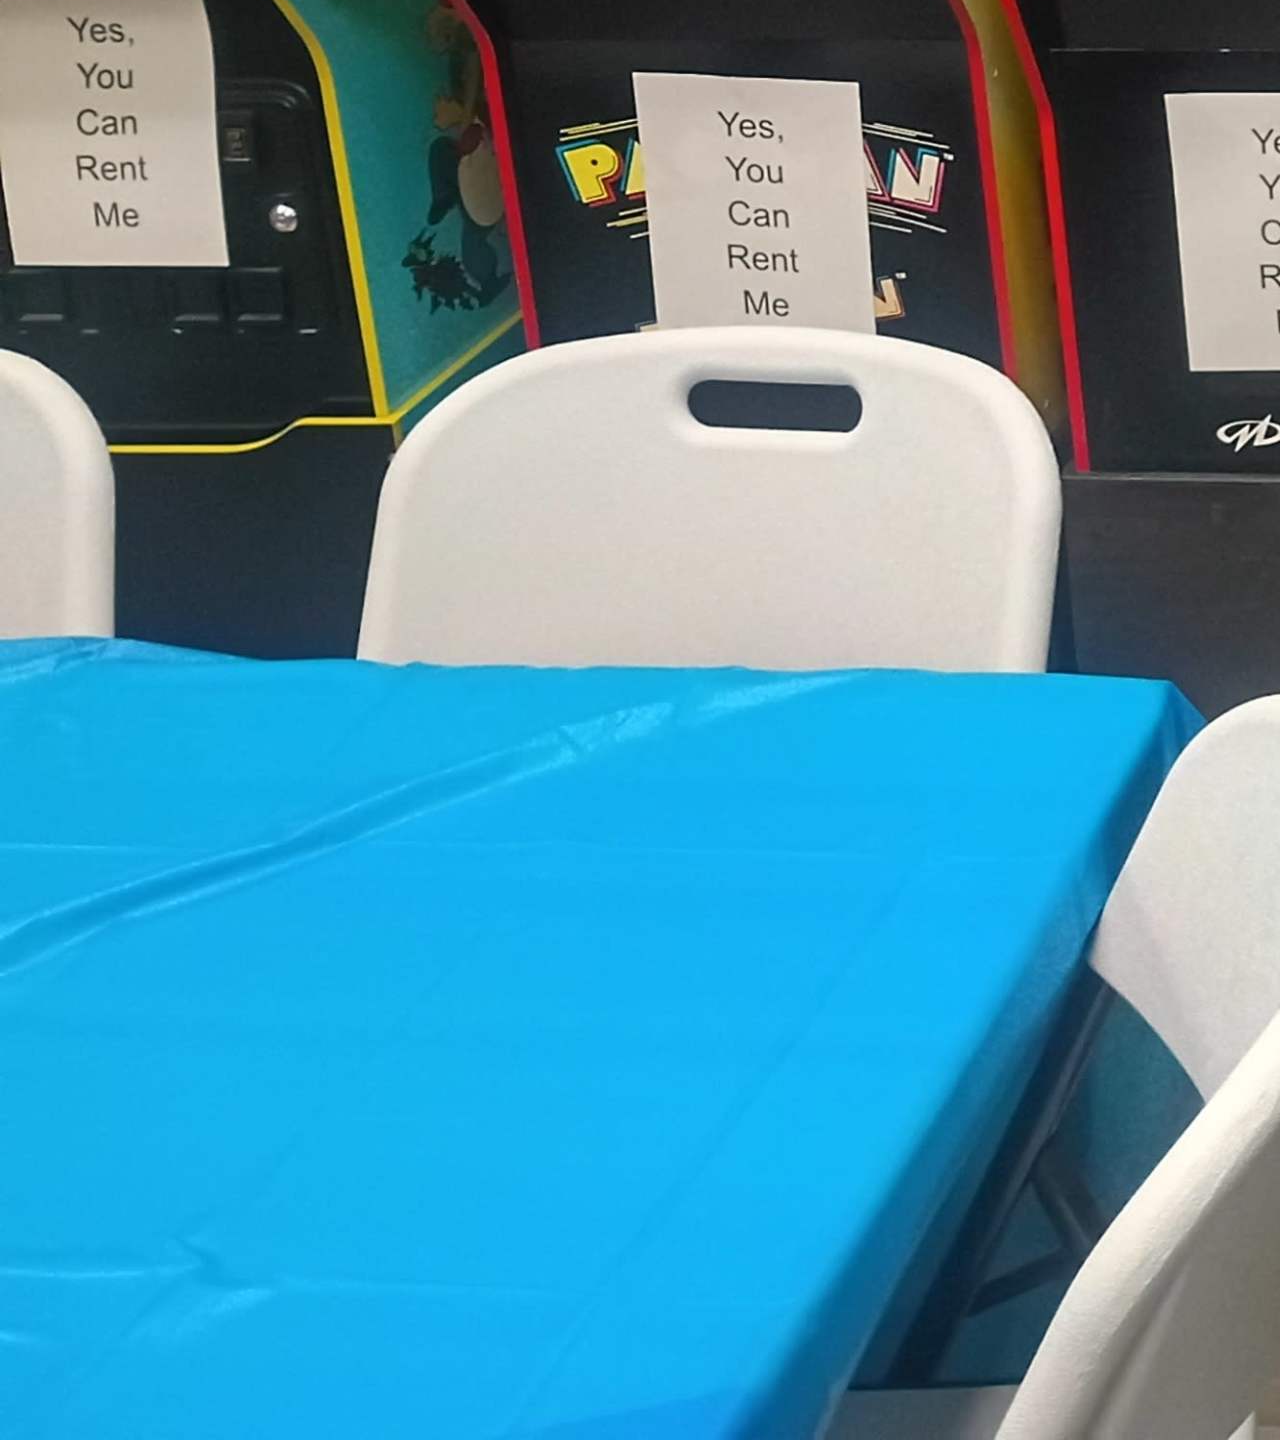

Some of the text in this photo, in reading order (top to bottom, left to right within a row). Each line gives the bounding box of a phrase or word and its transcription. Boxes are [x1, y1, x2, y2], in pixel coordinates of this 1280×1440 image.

[67, 17, 135, 47] Yes,
[77, 63, 134, 89] You
[76, 109, 138, 136] Can
[717, 111, 785, 143] Yes,
[76, 155, 148, 181] Rent
[725, 157, 784, 185] You
[93, 202, 140, 228] Me
[727, 201, 790, 229] Can
[726, 244, 800, 274] Rent
[743, 290, 790, 318] Me
